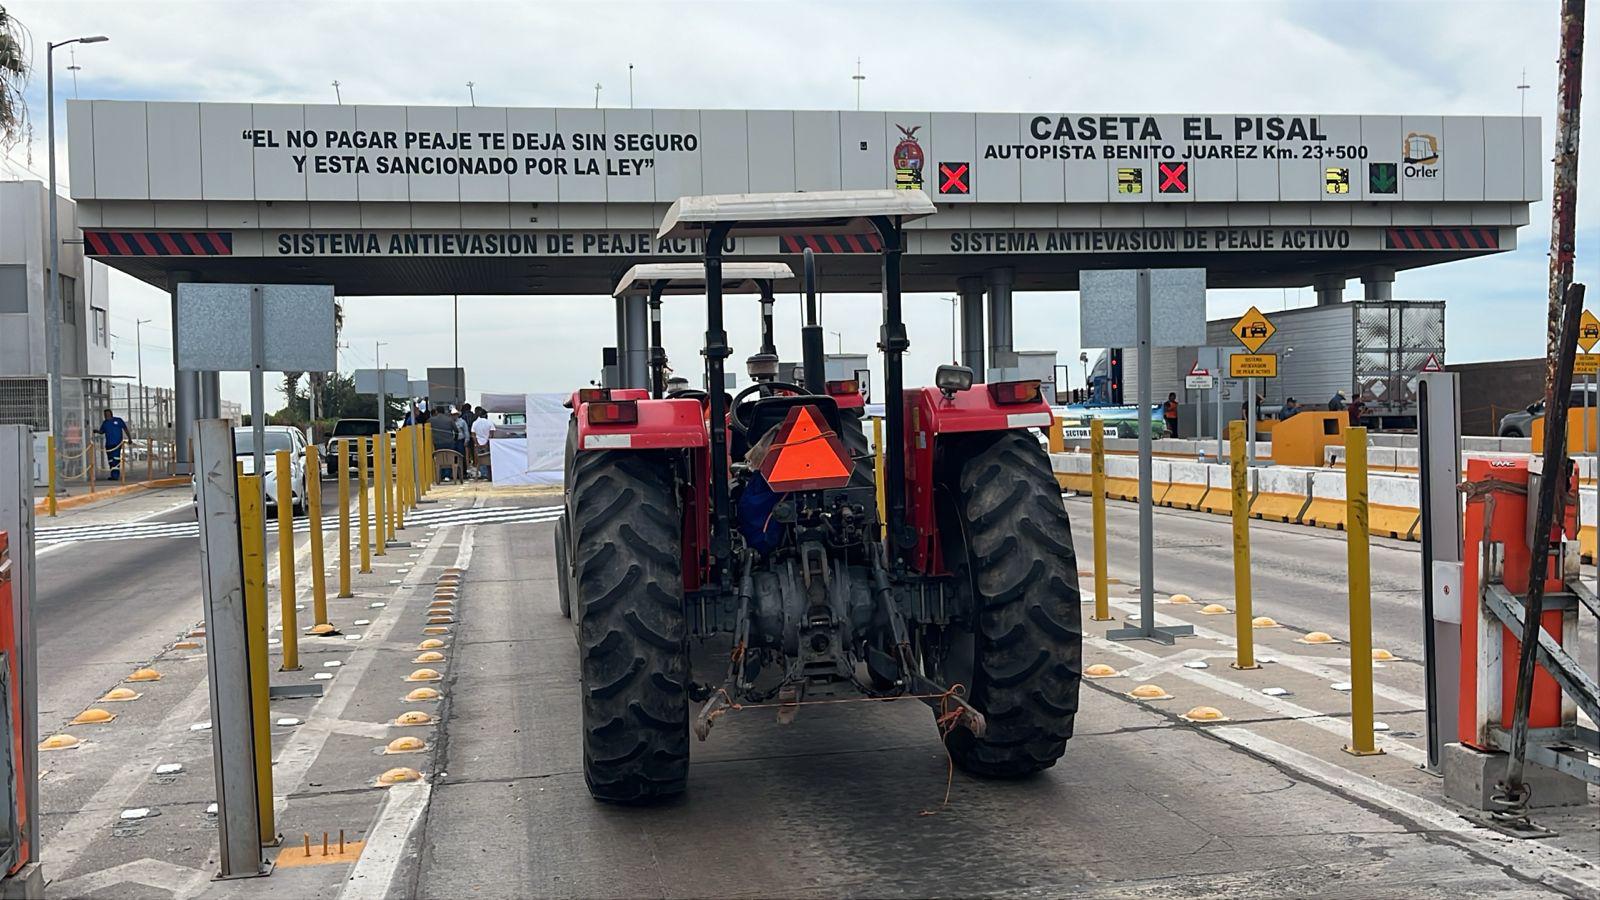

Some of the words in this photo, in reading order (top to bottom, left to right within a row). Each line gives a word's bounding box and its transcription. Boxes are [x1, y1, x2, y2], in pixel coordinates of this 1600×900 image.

[1030, 116, 1162, 141] CASETA
[1184, 117, 1223, 141] EL
[1235, 117, 1327, 141] PISAL
[286, 130, 318, 148] NO
[325, 131, 398, 149] PAGAR
[405, 132, 472, 150] PEAJE
[478, 132, 505, 150] TE
[512, 133, 566, 151] DEJA
[572, 133, 607, 151] SIN
[614, 134, 698, 152] SEGURO
[984, 144, 1096, 160] AUTOPISTA
[1103, 144, 1175, 160] BENITO
[1182, 145, 1258, 160] JUAREZ
[1264, 145, 1298, 160] Km.
[1302, 145, 1368, 160] 23+500
[293, 155, 307, 173] Y
[314, 156, 370, 174] ESTA
[376, 156, 518, 175] SANCIONADO
[525, 157, 568, 175] POR
[574, 158, 600, 176] LA
[1404, 165, 1438, 178] Orler
[278, 234, 381, 255] SISTEMA
[388, 234, 538, 255] ANTIEVASION
[546, 233, 574, 254] DE
[582, 233, 650, 254] PEAJE
[951, 232, 1040, 252] SISTEMA
[1045, 231, 1176, 251] ANTIEVASION
[1183, 230, 1208, 249] DE
[1215, 230, 1274, 249] PEAJE
[1281, 230, 1350, 249] ACTIVO
